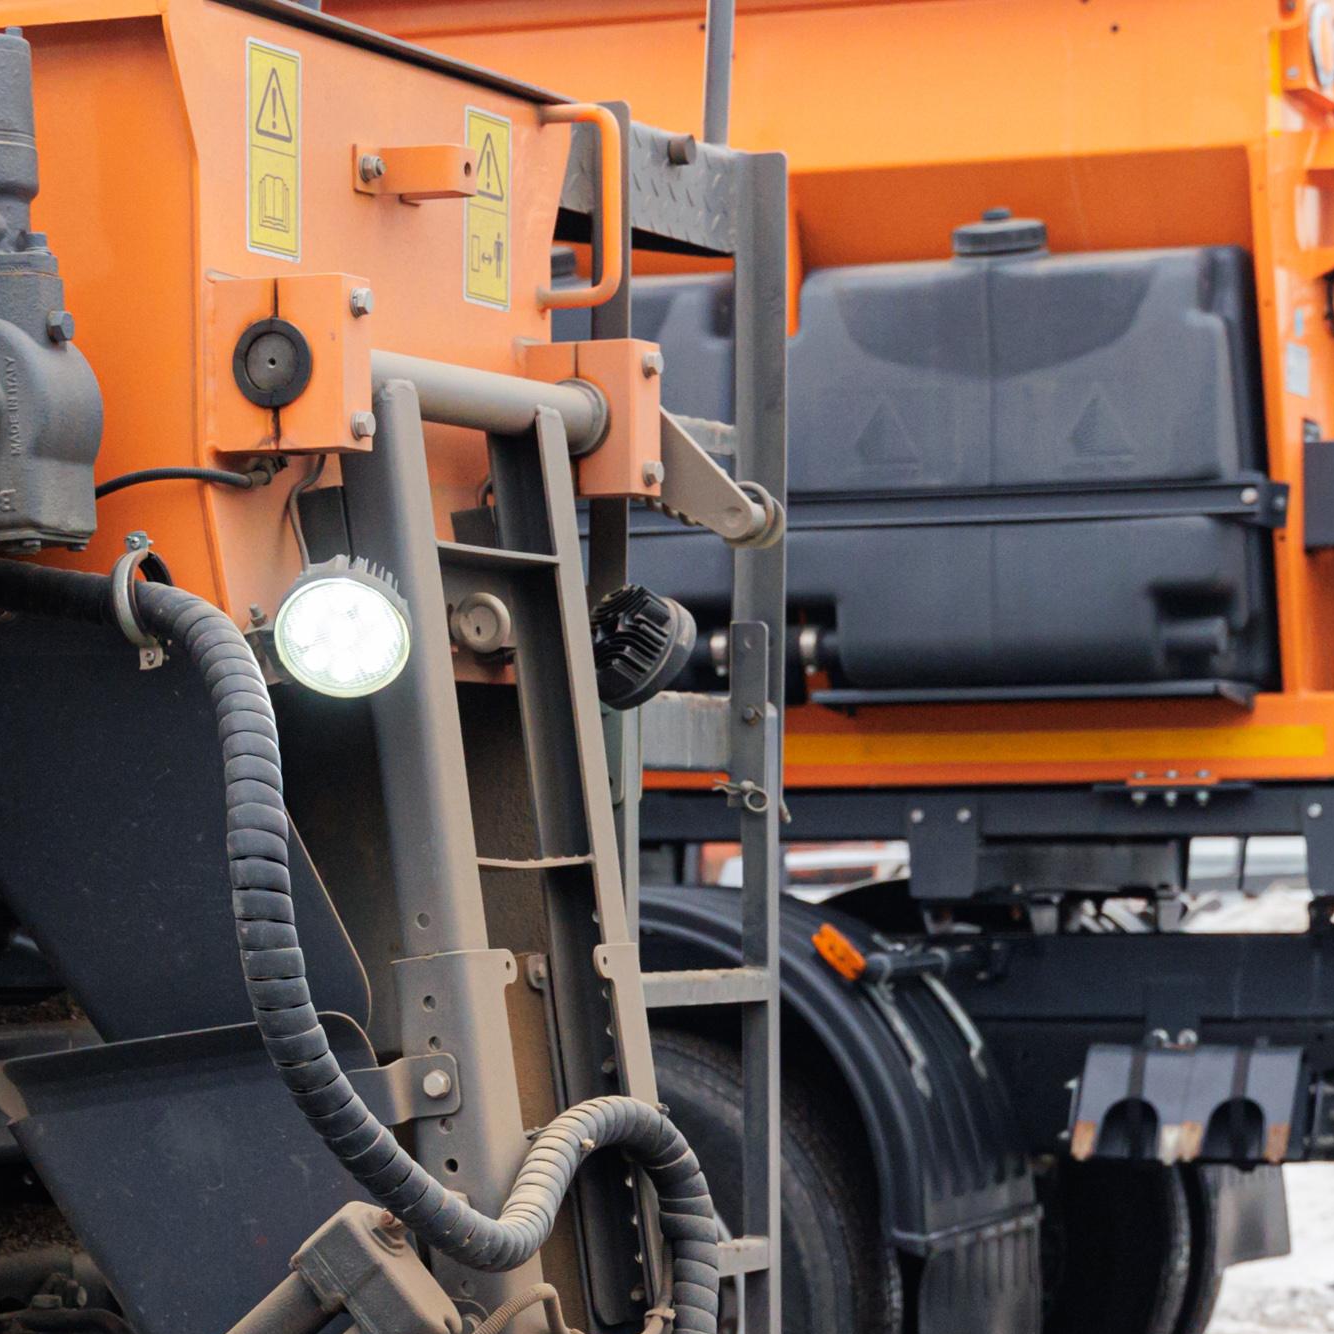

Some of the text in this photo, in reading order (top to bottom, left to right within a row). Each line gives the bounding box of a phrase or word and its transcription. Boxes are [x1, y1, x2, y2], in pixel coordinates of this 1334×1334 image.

[5, 356, 22, 457] MADE IN ITALY
